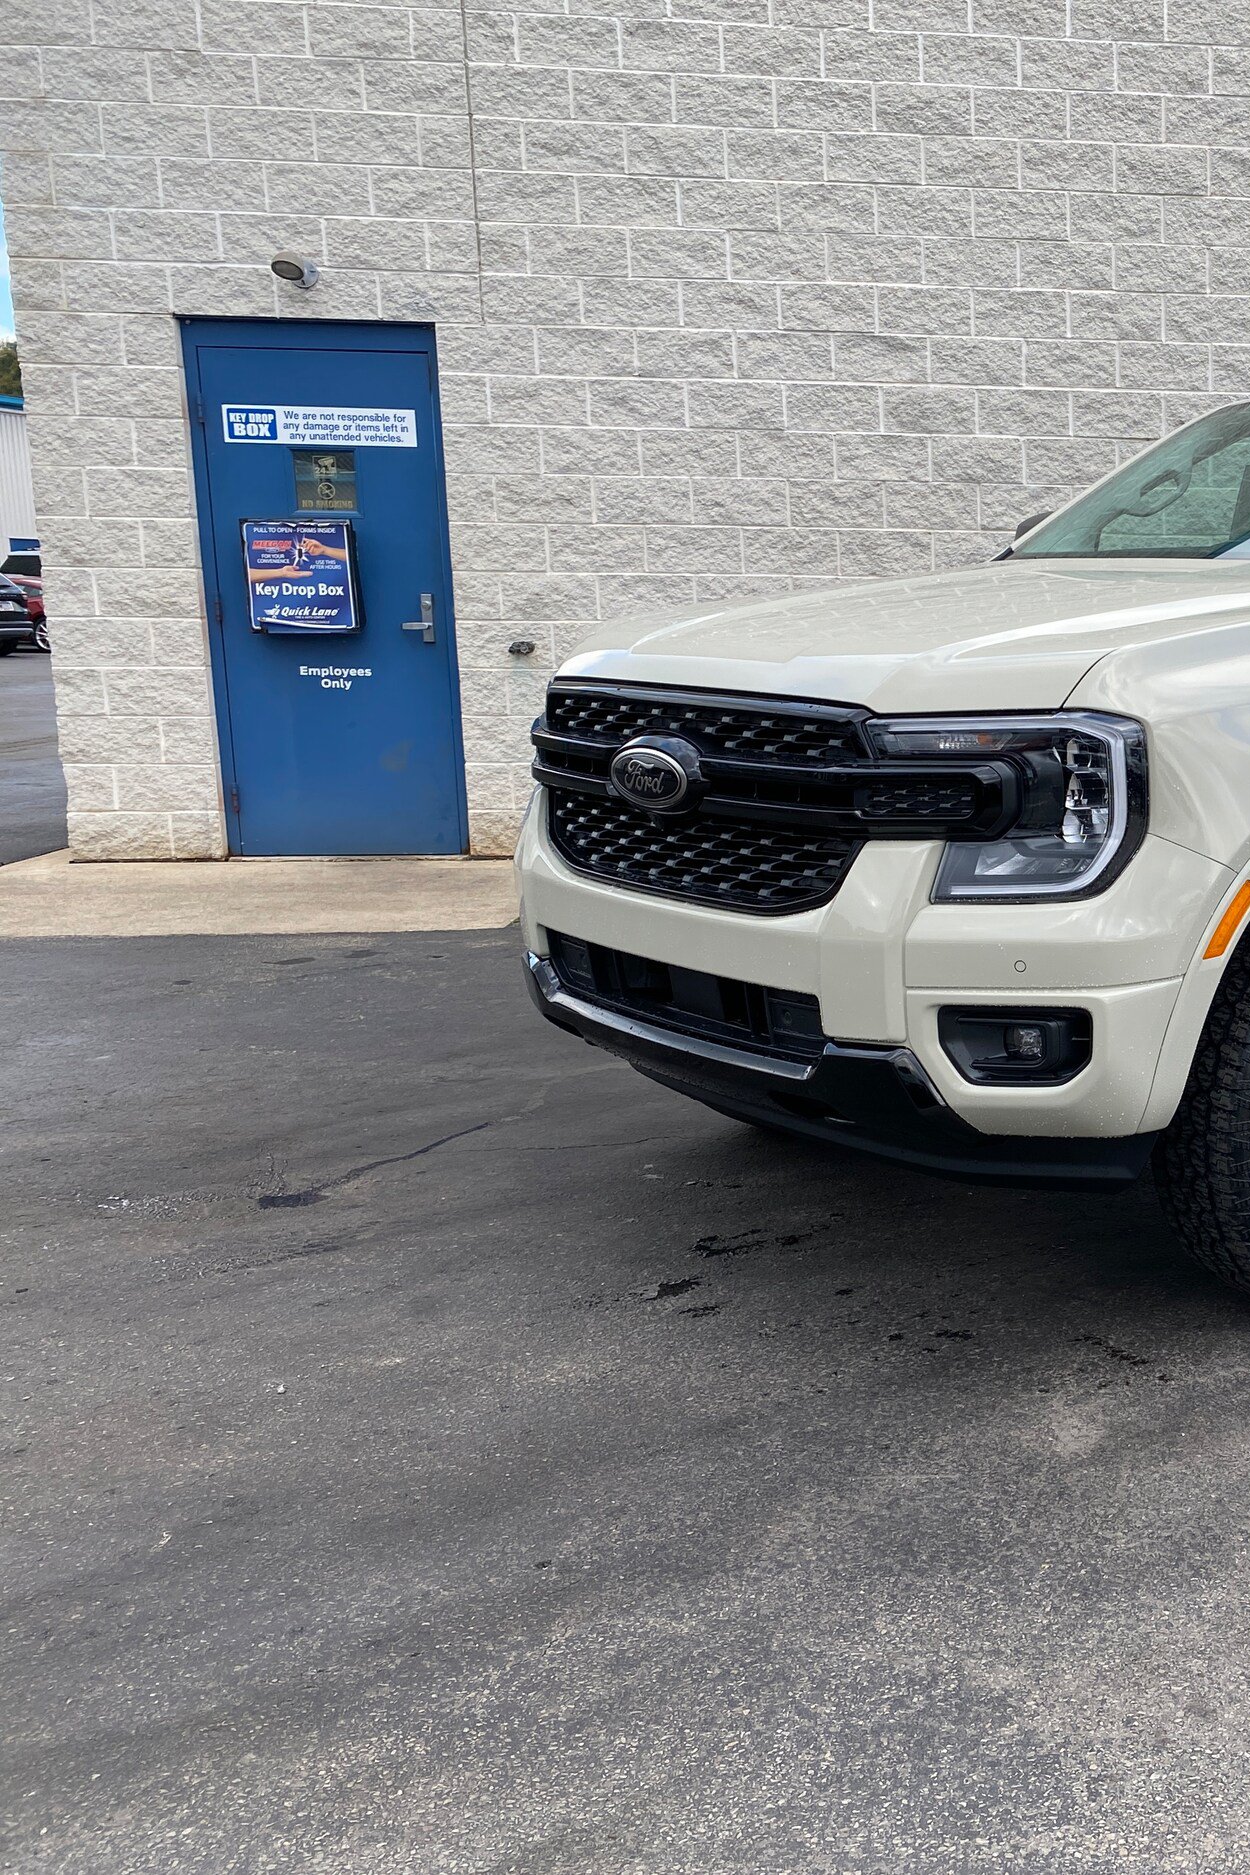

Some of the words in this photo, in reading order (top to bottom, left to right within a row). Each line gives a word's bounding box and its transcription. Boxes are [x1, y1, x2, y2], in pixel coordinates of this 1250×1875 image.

[229, 412, 247, 423] KEY
[248, 412, 275, 424] DROP
[283, 411, 300, 420] We
[302, 413, 317, 421] are
[319, 413, 335, 421] not
[337, 413, 391, 423] responsible
[393, 414, 407, 423] for
[233, 422, 272, 437] BOX
[283, 422, 300, 431] any
[303, 422, 340, 433] damage
[342, 424, 353, 432] or
[355, 423, 381, 432] items
[383, 424, 398, 433] left
[400, 424, 409, 433] in
[289, 433, 306, 441] any
[309, 433, 361, 442] unattended
[364, 434, 404, 443] vehicles.
[302, 500, 314, 508] NO
[315, 500, 353, 509] SMOKING
[255, 583, 279, 598] Key
[282, 583, 316, 598] Drop
[318, 584, 344, 596] Box
[281, 606, 311, 617] Quick
[311, 607, 339, 616] Lane
[299, 665, 372, 678] Employees
[321, 678, 352, 691] Only
[624, 758, 665, 795] Ford
